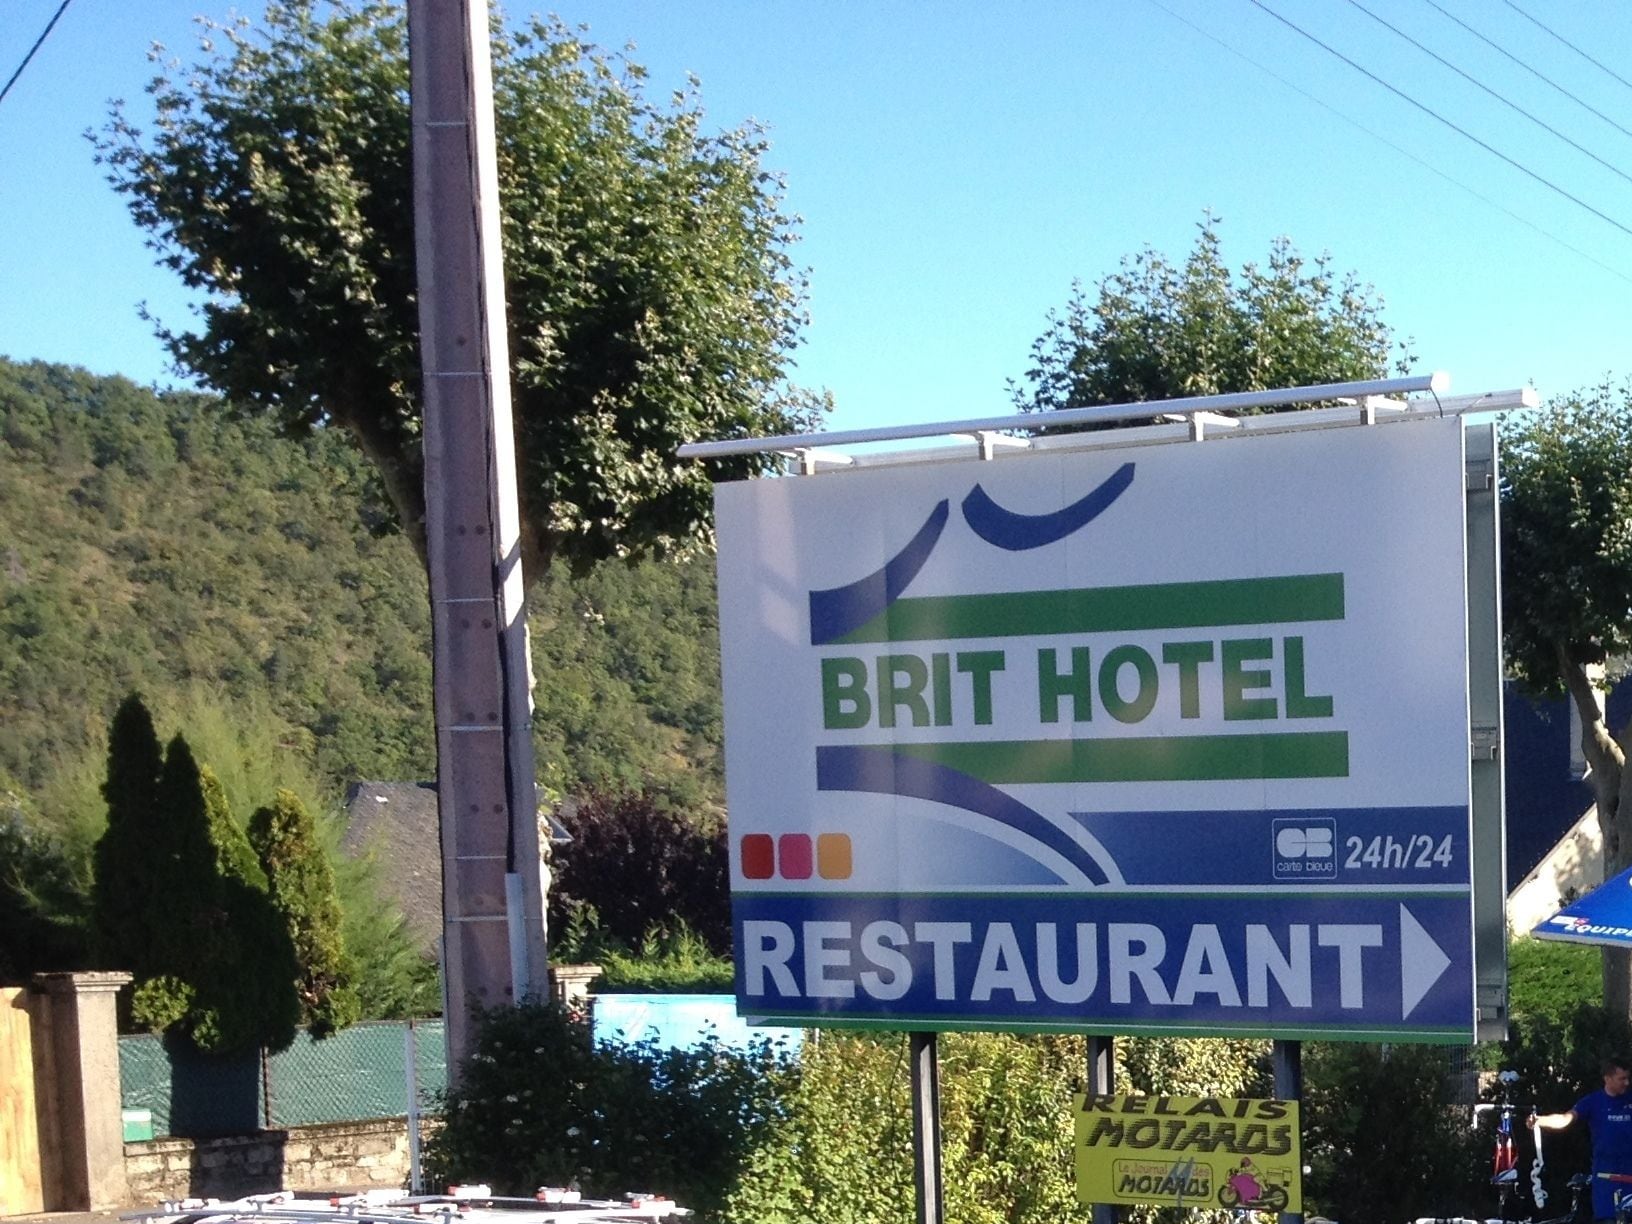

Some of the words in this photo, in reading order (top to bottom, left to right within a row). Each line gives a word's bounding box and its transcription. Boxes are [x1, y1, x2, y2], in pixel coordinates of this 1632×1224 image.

[821, 650, 1005, 731] BRIT
[1038, 636, 1334, 724] HOTEL
[1344, 834, 1453, 869] 24h/24
[1277, 862, 1302, 872] carte
[1306, 862, 1333, 872] bleue
[743, 920, 1383, 1009] RESTAURANT
[1081, 1094, 1288, 1120] RELAIS
[1086, 1117, 1292, 1155] MOTARDS
[1118, 1162, 1130, 1172] Le
[1131, 1162, 1167, 1174] Journal
[1118, 1174, 1210, 1197] MOTARDS
